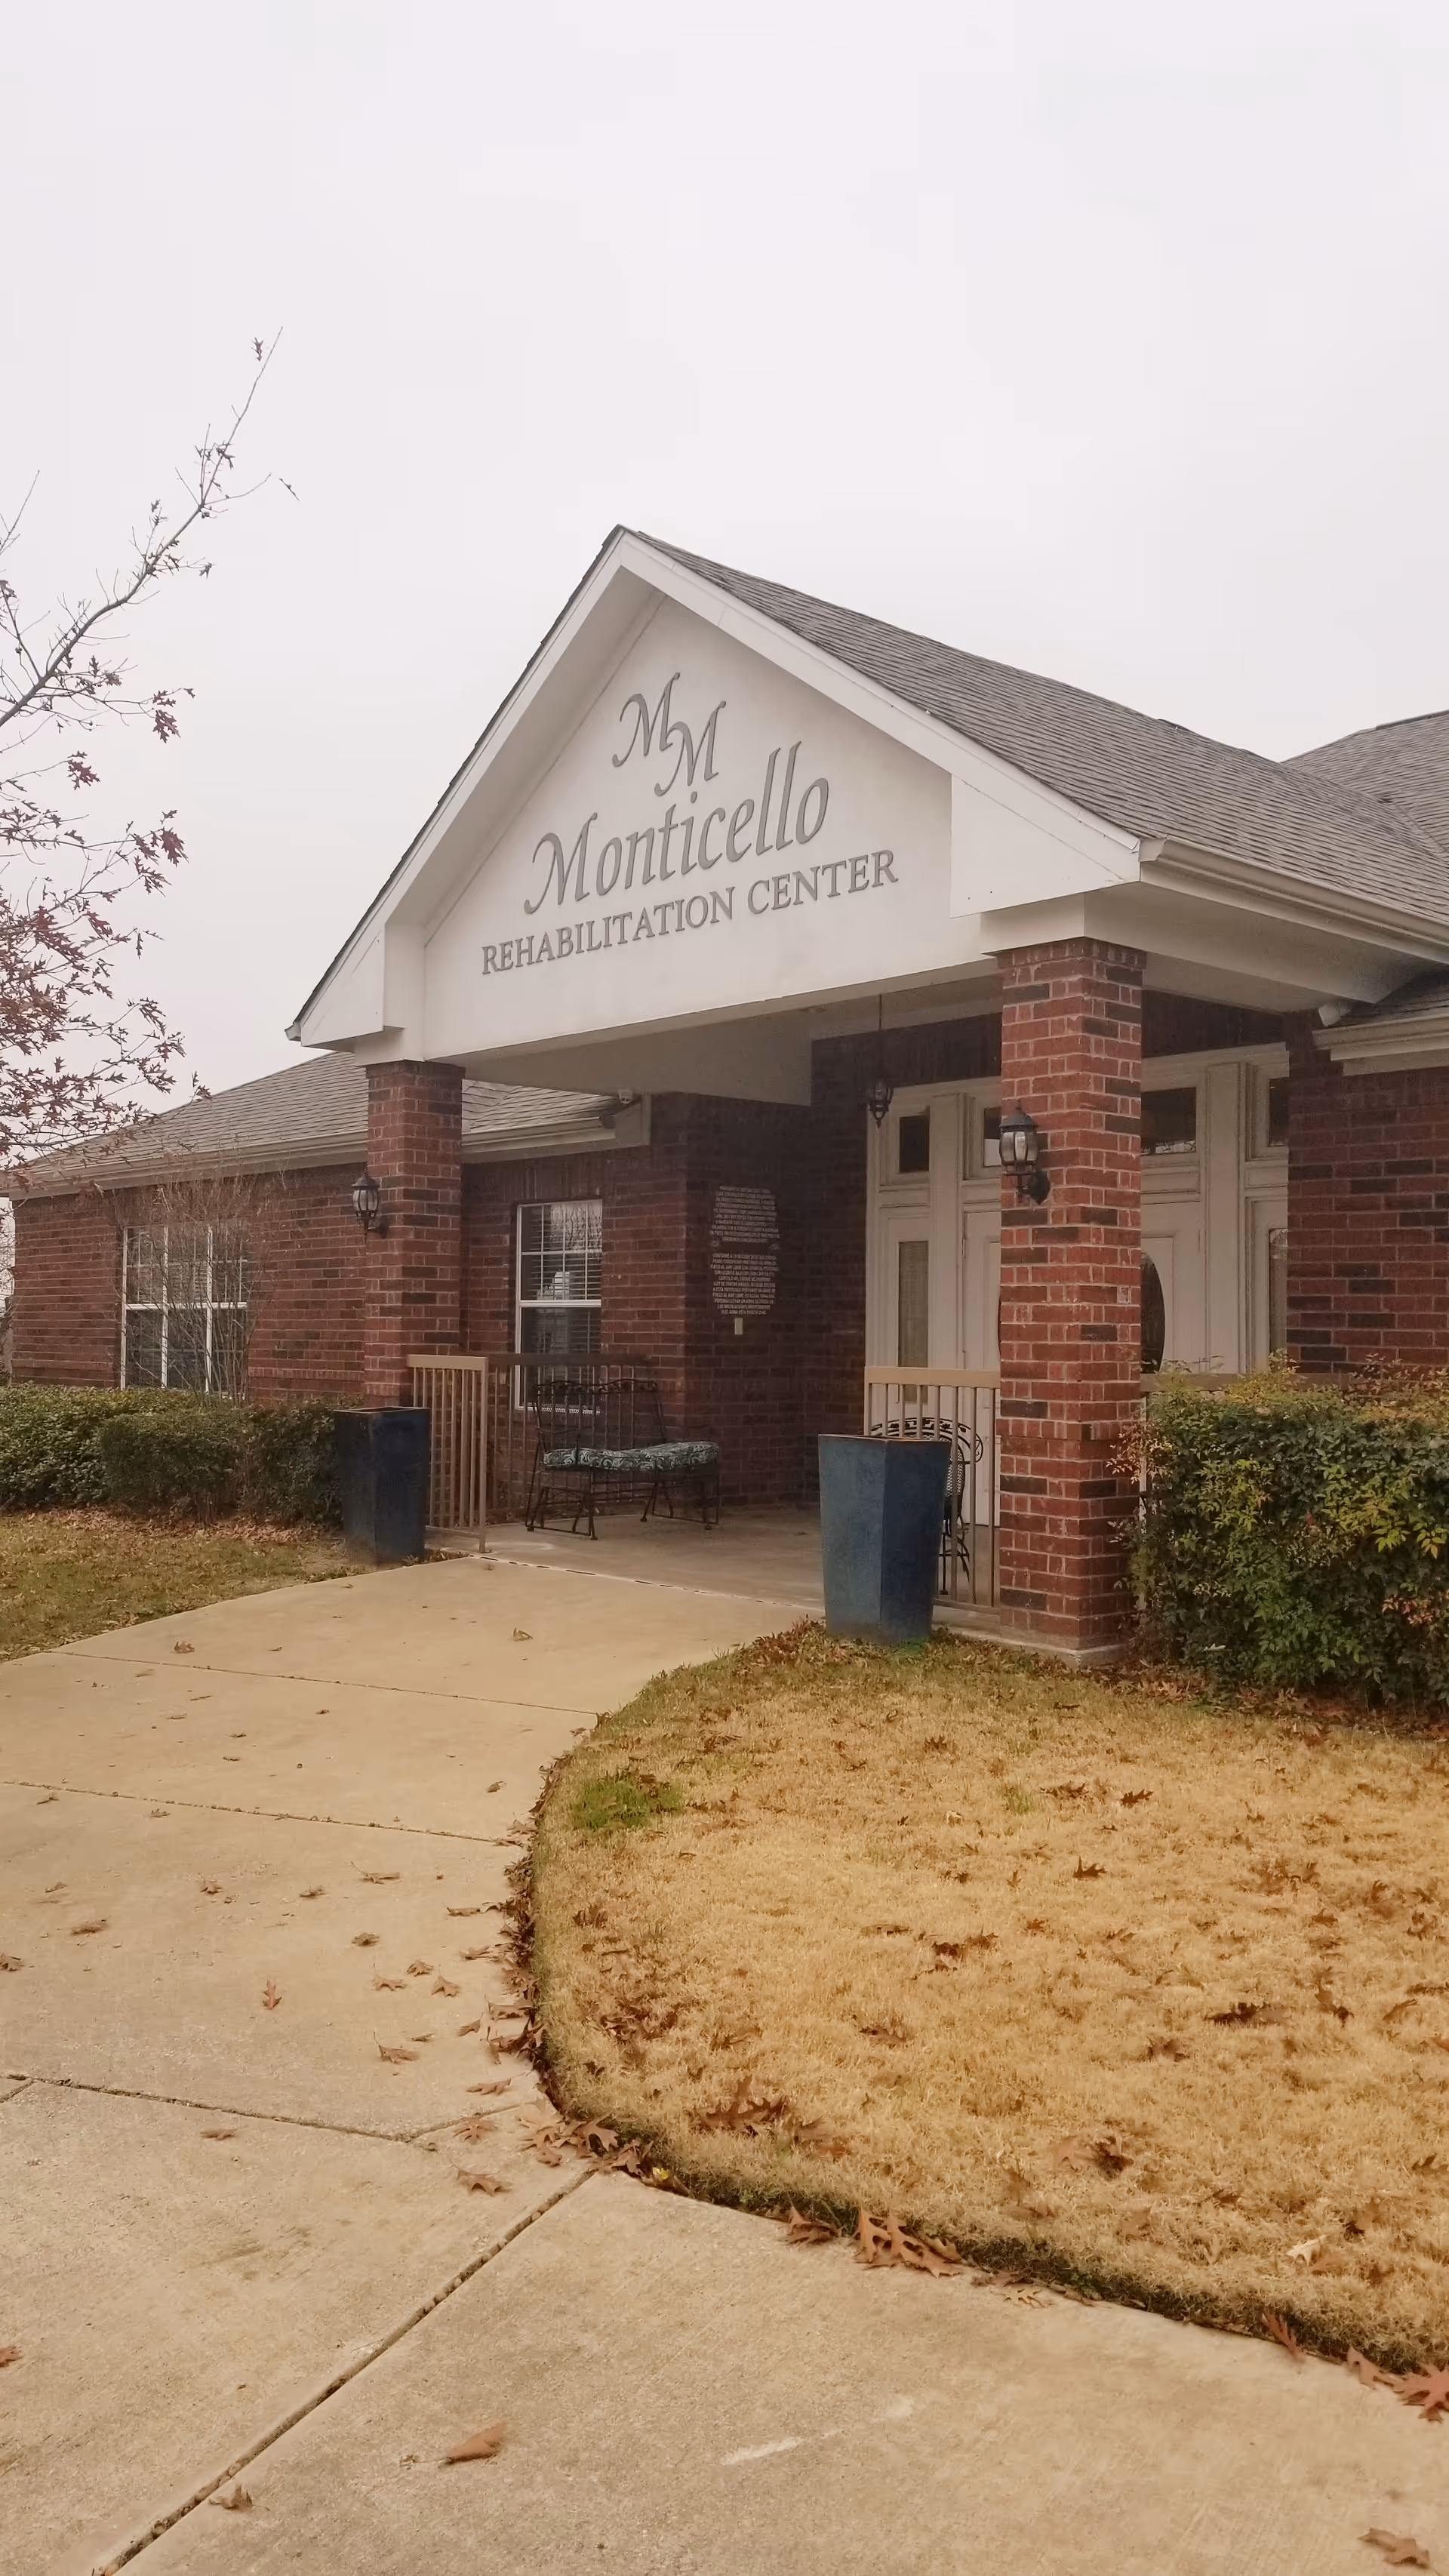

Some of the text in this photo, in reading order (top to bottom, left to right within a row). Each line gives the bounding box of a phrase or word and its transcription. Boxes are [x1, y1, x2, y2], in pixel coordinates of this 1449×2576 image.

[524, 741, 829, 914] Monticello
[481, 849, 898, 974] REHABILITATION CENTER
